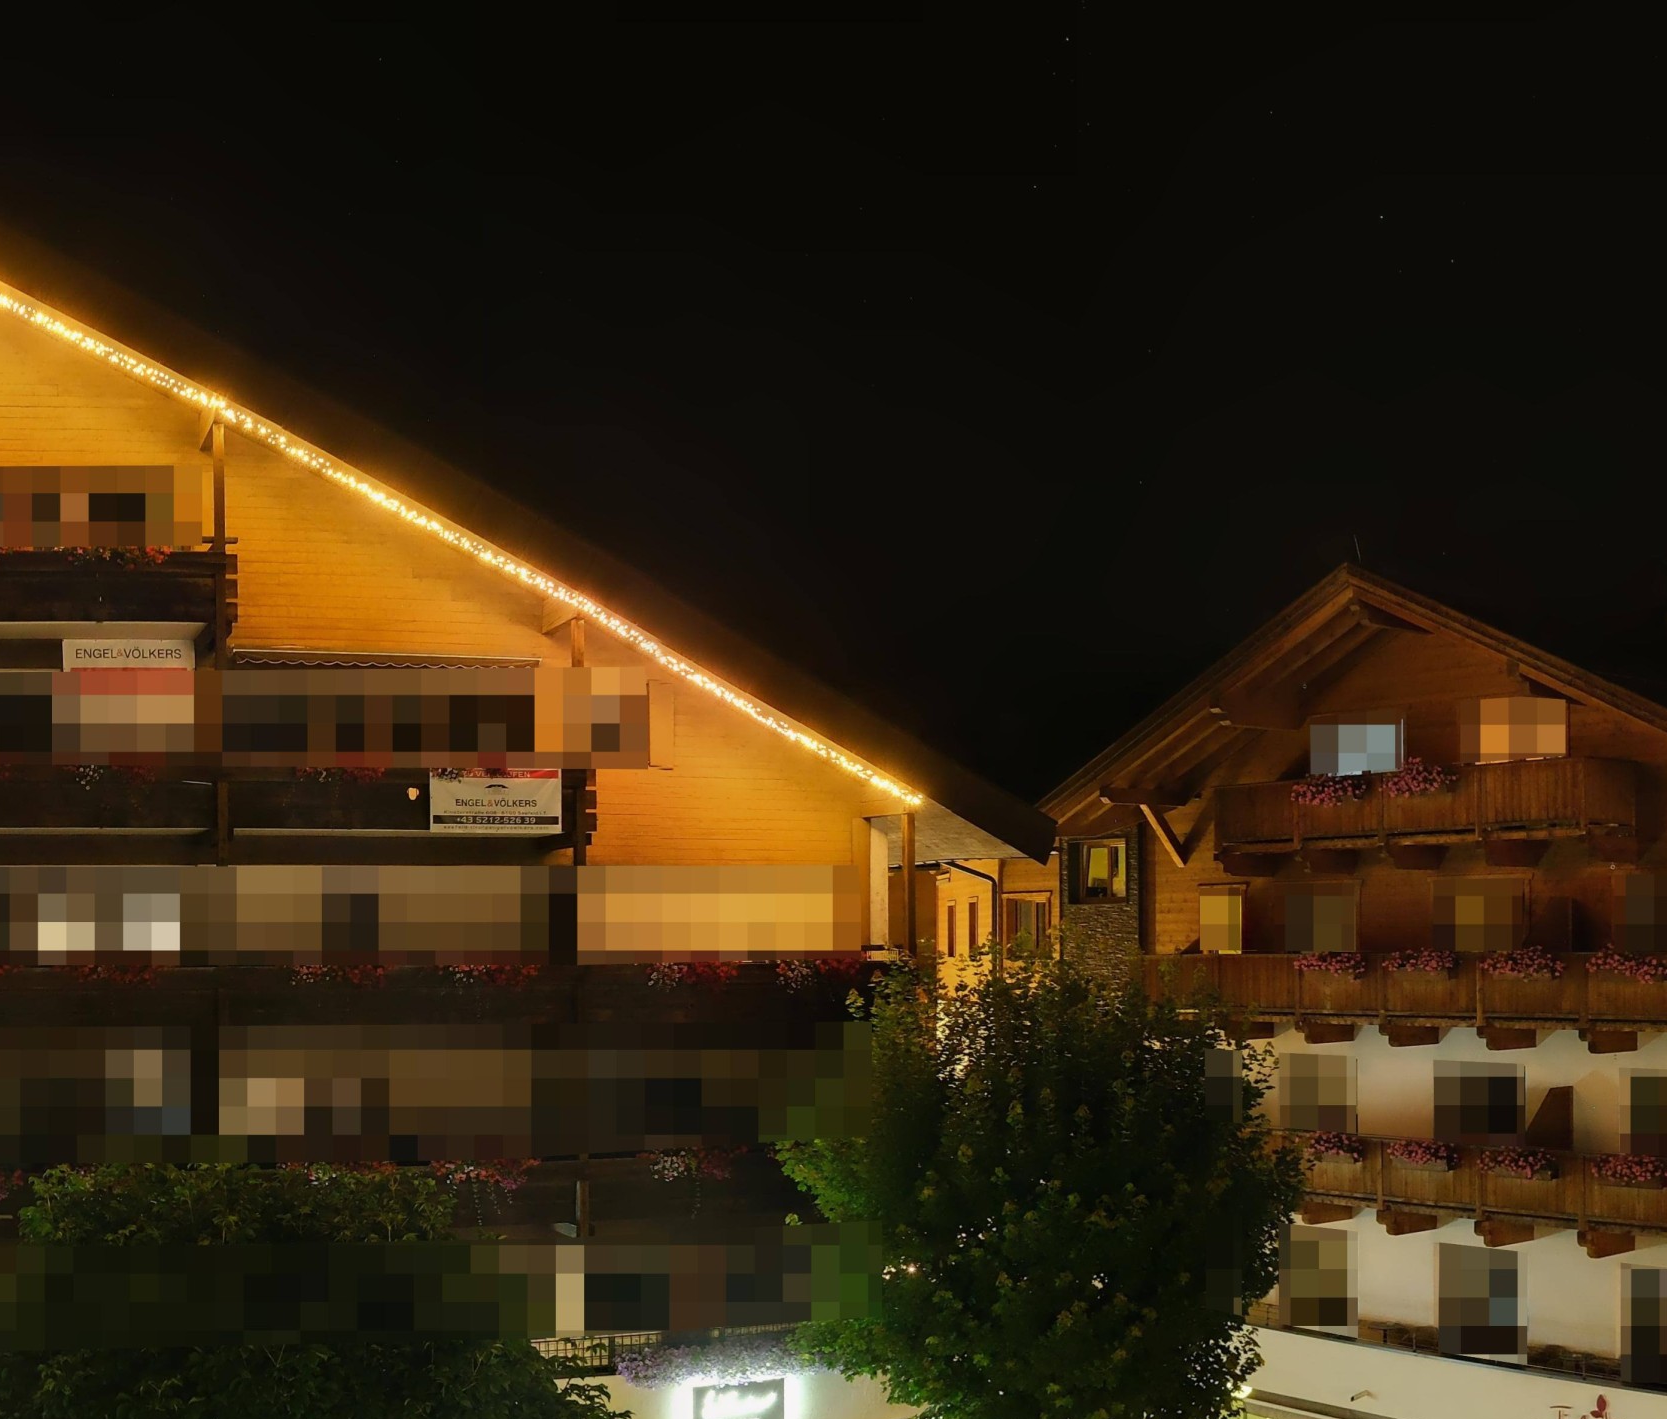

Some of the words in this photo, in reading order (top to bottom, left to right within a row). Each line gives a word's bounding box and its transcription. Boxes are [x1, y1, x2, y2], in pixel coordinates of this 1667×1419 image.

[75, 646, 182, 659] ENGEL&VÖLKERS
[455, 797, 537, 808] ENGEL&VÖLKERS
[457, 816, 473, 824] +43
[475, 816, 522, 824] 5212-526
[523, 816, 536, 824] 39
